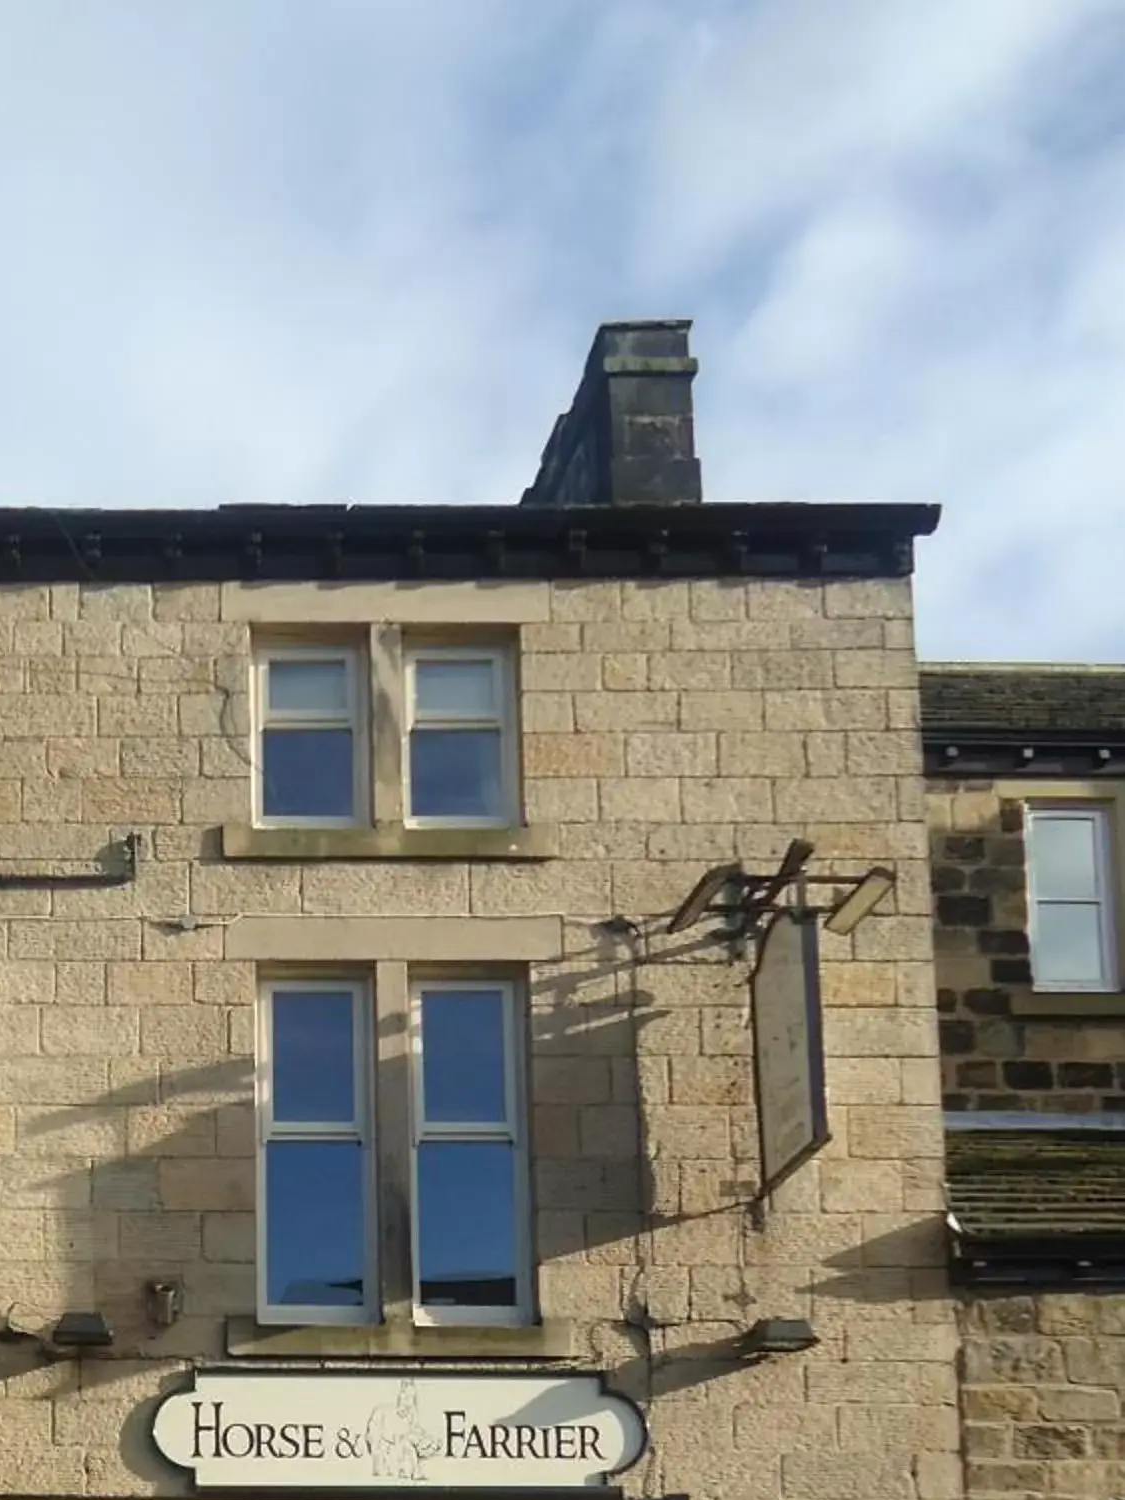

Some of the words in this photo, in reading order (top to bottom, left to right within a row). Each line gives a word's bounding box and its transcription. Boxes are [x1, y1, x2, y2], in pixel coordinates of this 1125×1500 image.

[191, 1402, 325, 1458] HORSE
[335, 1428, 365, 1458] &
[443, 1411, 606, 1459] FARRIER
